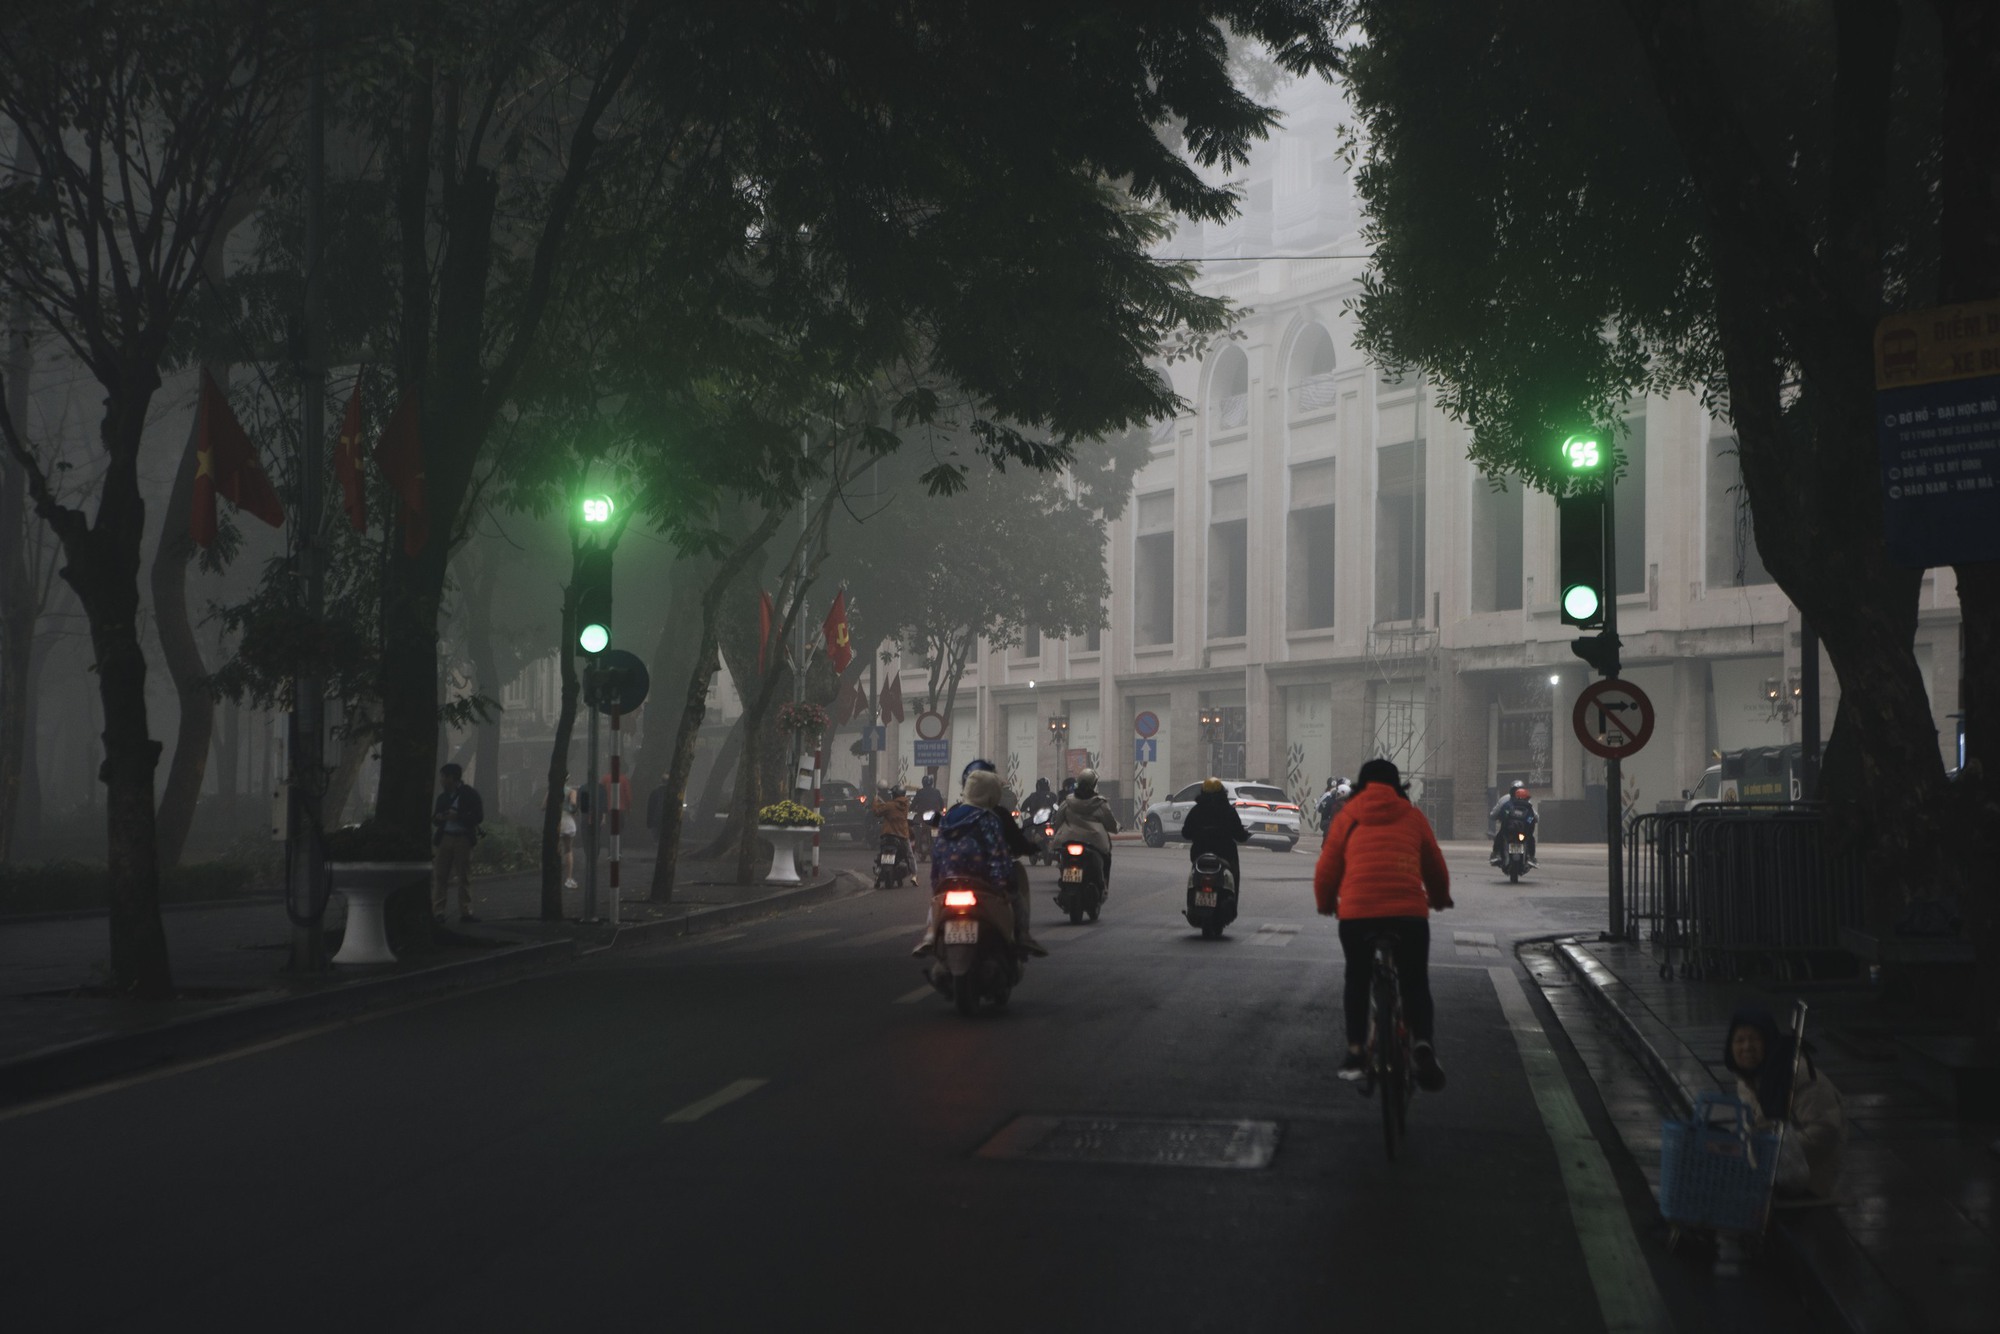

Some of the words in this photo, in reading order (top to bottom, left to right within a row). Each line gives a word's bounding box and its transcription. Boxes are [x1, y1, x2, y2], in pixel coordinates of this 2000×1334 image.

[1952, 352, 1974, 373] XE
[1570, 441, 1599, 468] 55
[1925, 481, 1948, 494] NAM
[1956, 478, 1976, 491] KIM
